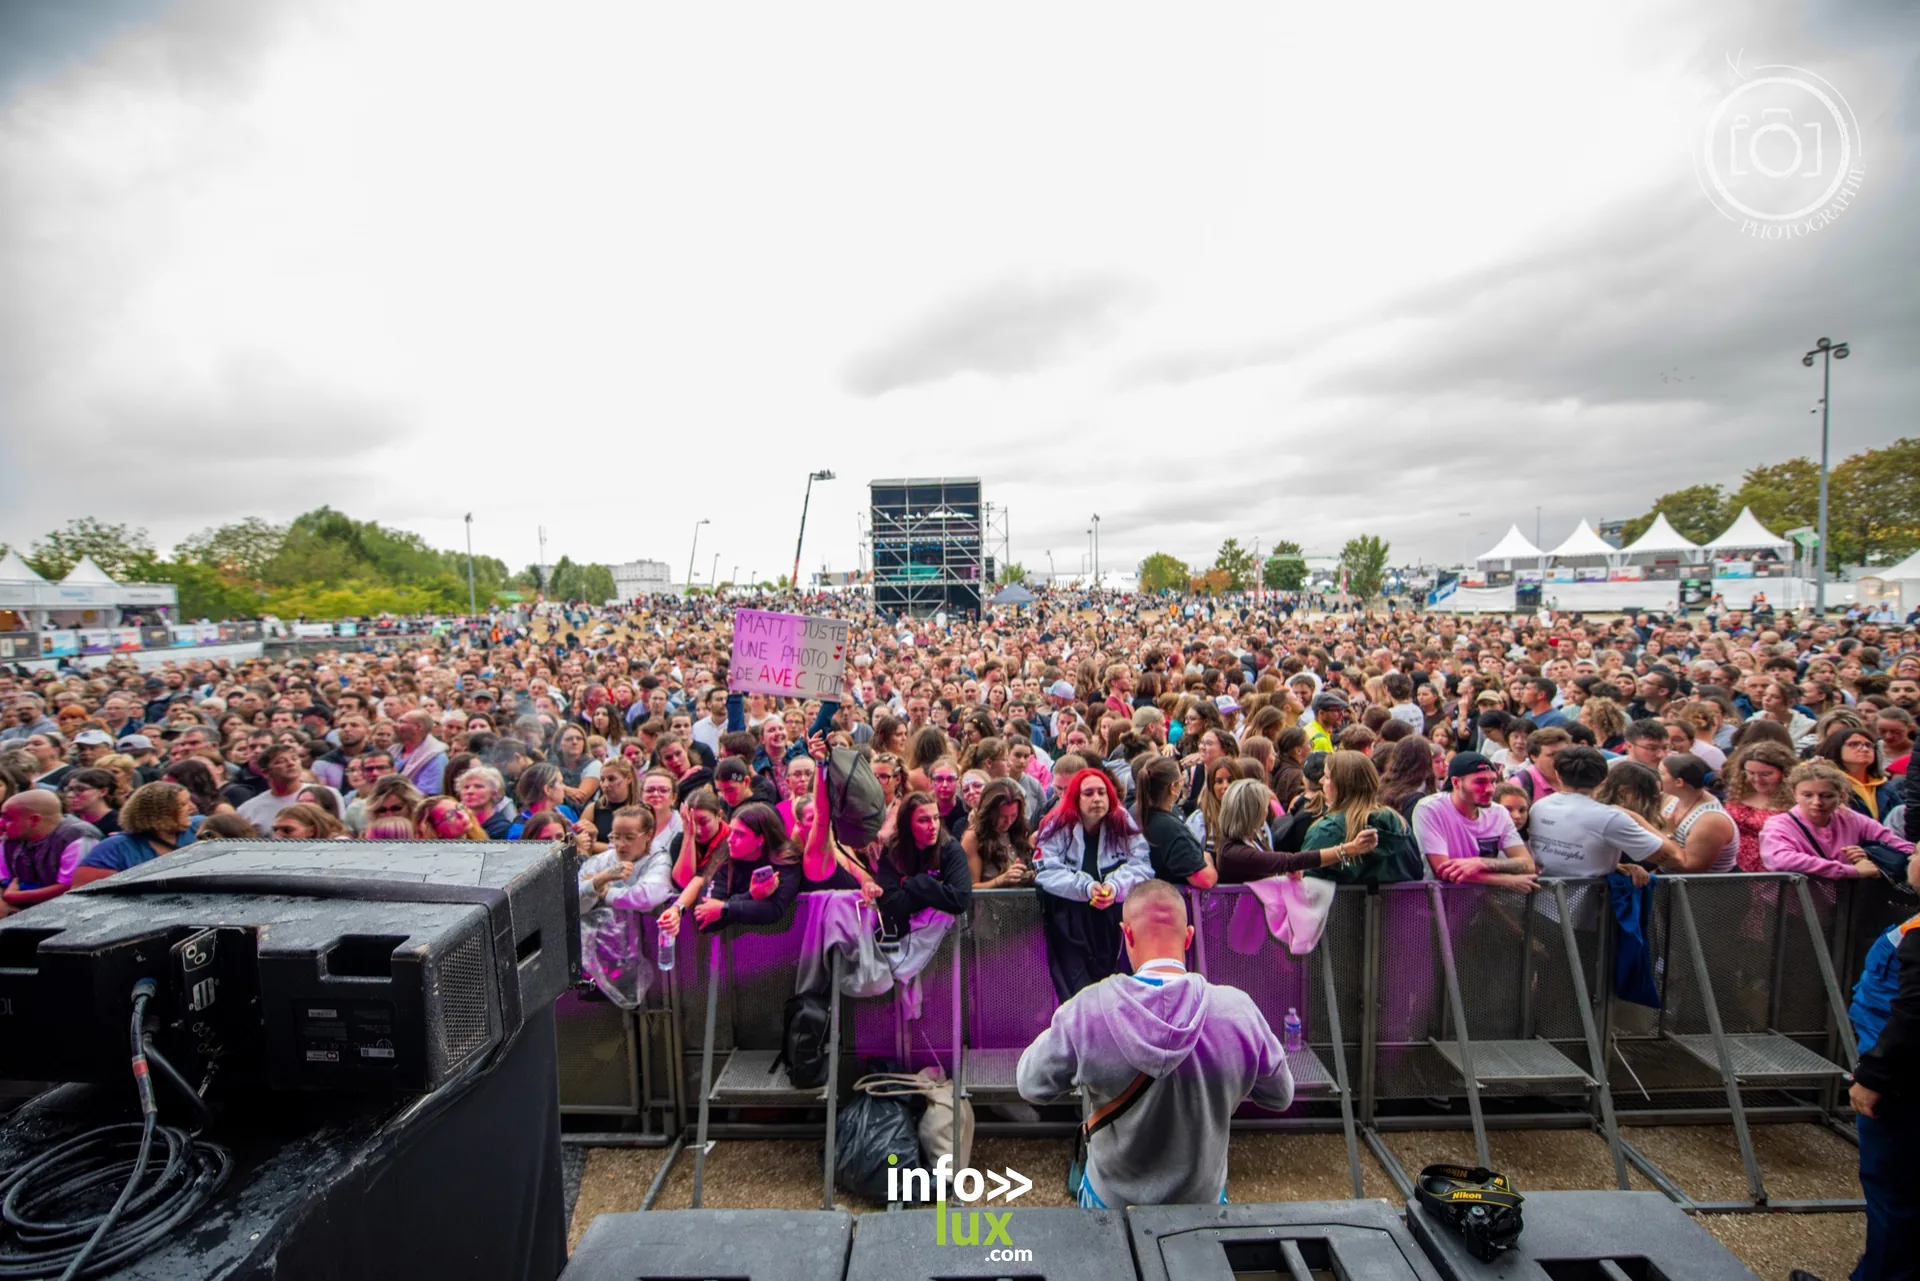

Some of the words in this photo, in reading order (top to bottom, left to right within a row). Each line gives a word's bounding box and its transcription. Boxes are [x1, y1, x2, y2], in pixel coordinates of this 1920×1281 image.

[738, 613, 789, 643] MATT,
[797, 619, 846, 642] JUSTE
[740, 640, 768, 660] UNE
[780, 645, 828, 669] PHOTO
[736, 666, 753, 681] DE
[758, 664, 806, 689] AVEC
[815, 673, 841, 696] TOI
[1452, 1191, 1482, 1200] Nikon
